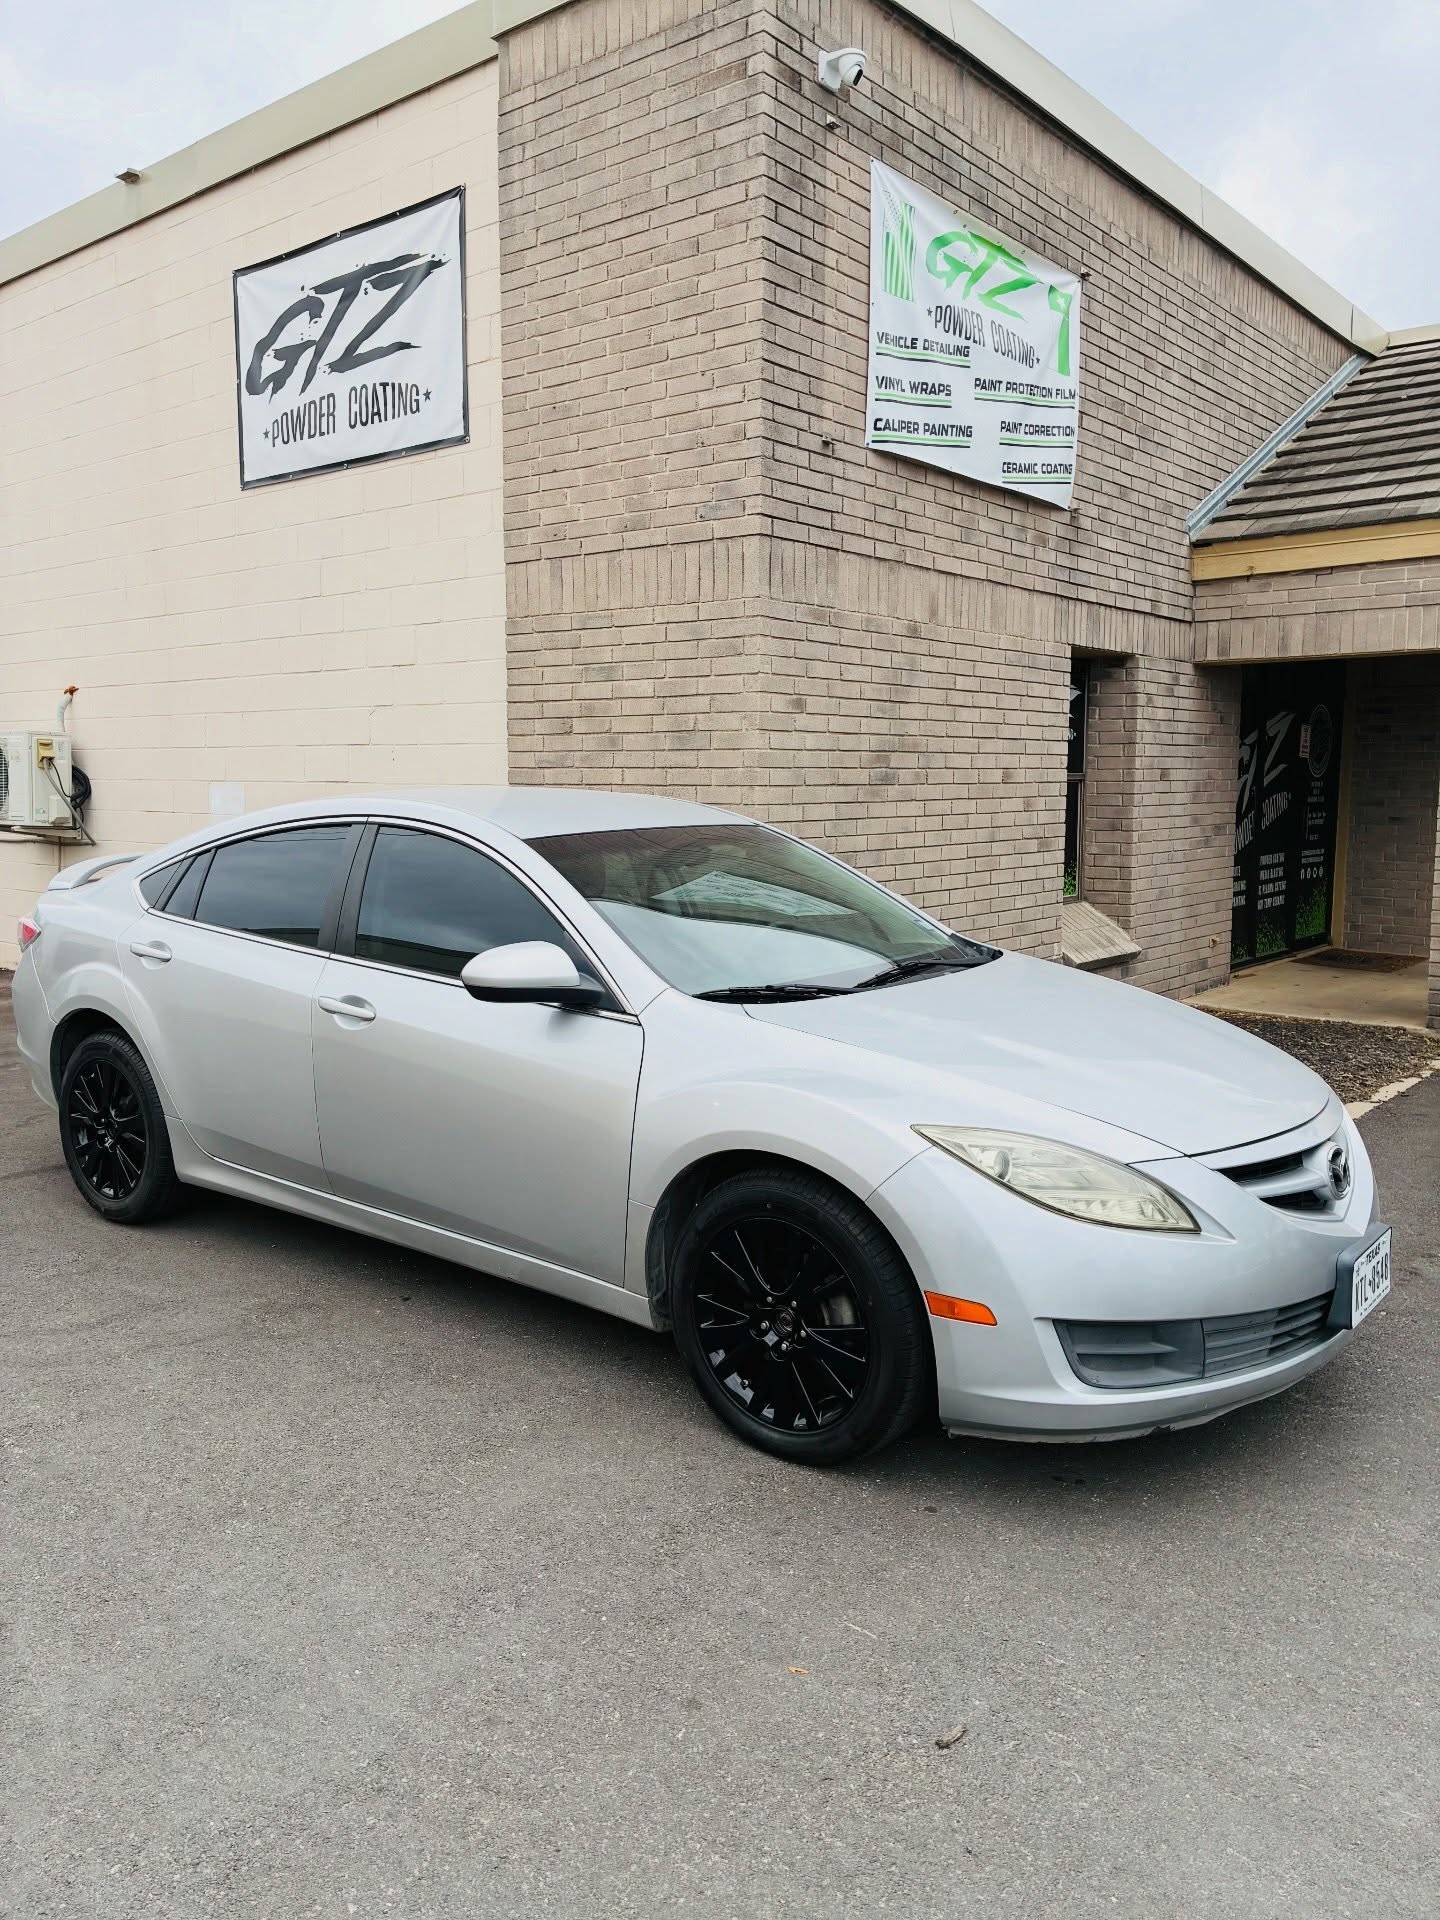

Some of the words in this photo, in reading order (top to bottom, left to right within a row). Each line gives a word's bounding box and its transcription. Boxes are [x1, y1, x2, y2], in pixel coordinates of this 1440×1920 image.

[926, 230, 1042, 320] GTZ
[245, 253, 451, 403] GTZ
[934, 304, 985, 347] POWDER
[991, 320, 1035, 369] COATING
[876, 331, 918, 350] VEHICLE
[922, 337, 970, 358] DETAILING
[875, 375, 907, 392] VINYL
[909, 380, 952, 397] WRAPS
[974, 377, 1003, 393] PAINT
[1055, 383, 1076, 400] FILM
[272, 393, 336, 447] POWDER
[348, 382, 420, 429] COATING
[873, 417, 920, 435] CALIPER
[923, 423, 973, 438] PAINTING
[1000, 420, 1022, 435] PAINT
[1023, 423, 1075, 437] CORRECTION
[1001, 461, 1038, 475] CERAMIC
[1041, 462, 1073, 475] COATING
[1261, 792, 1288, 830] COATING
